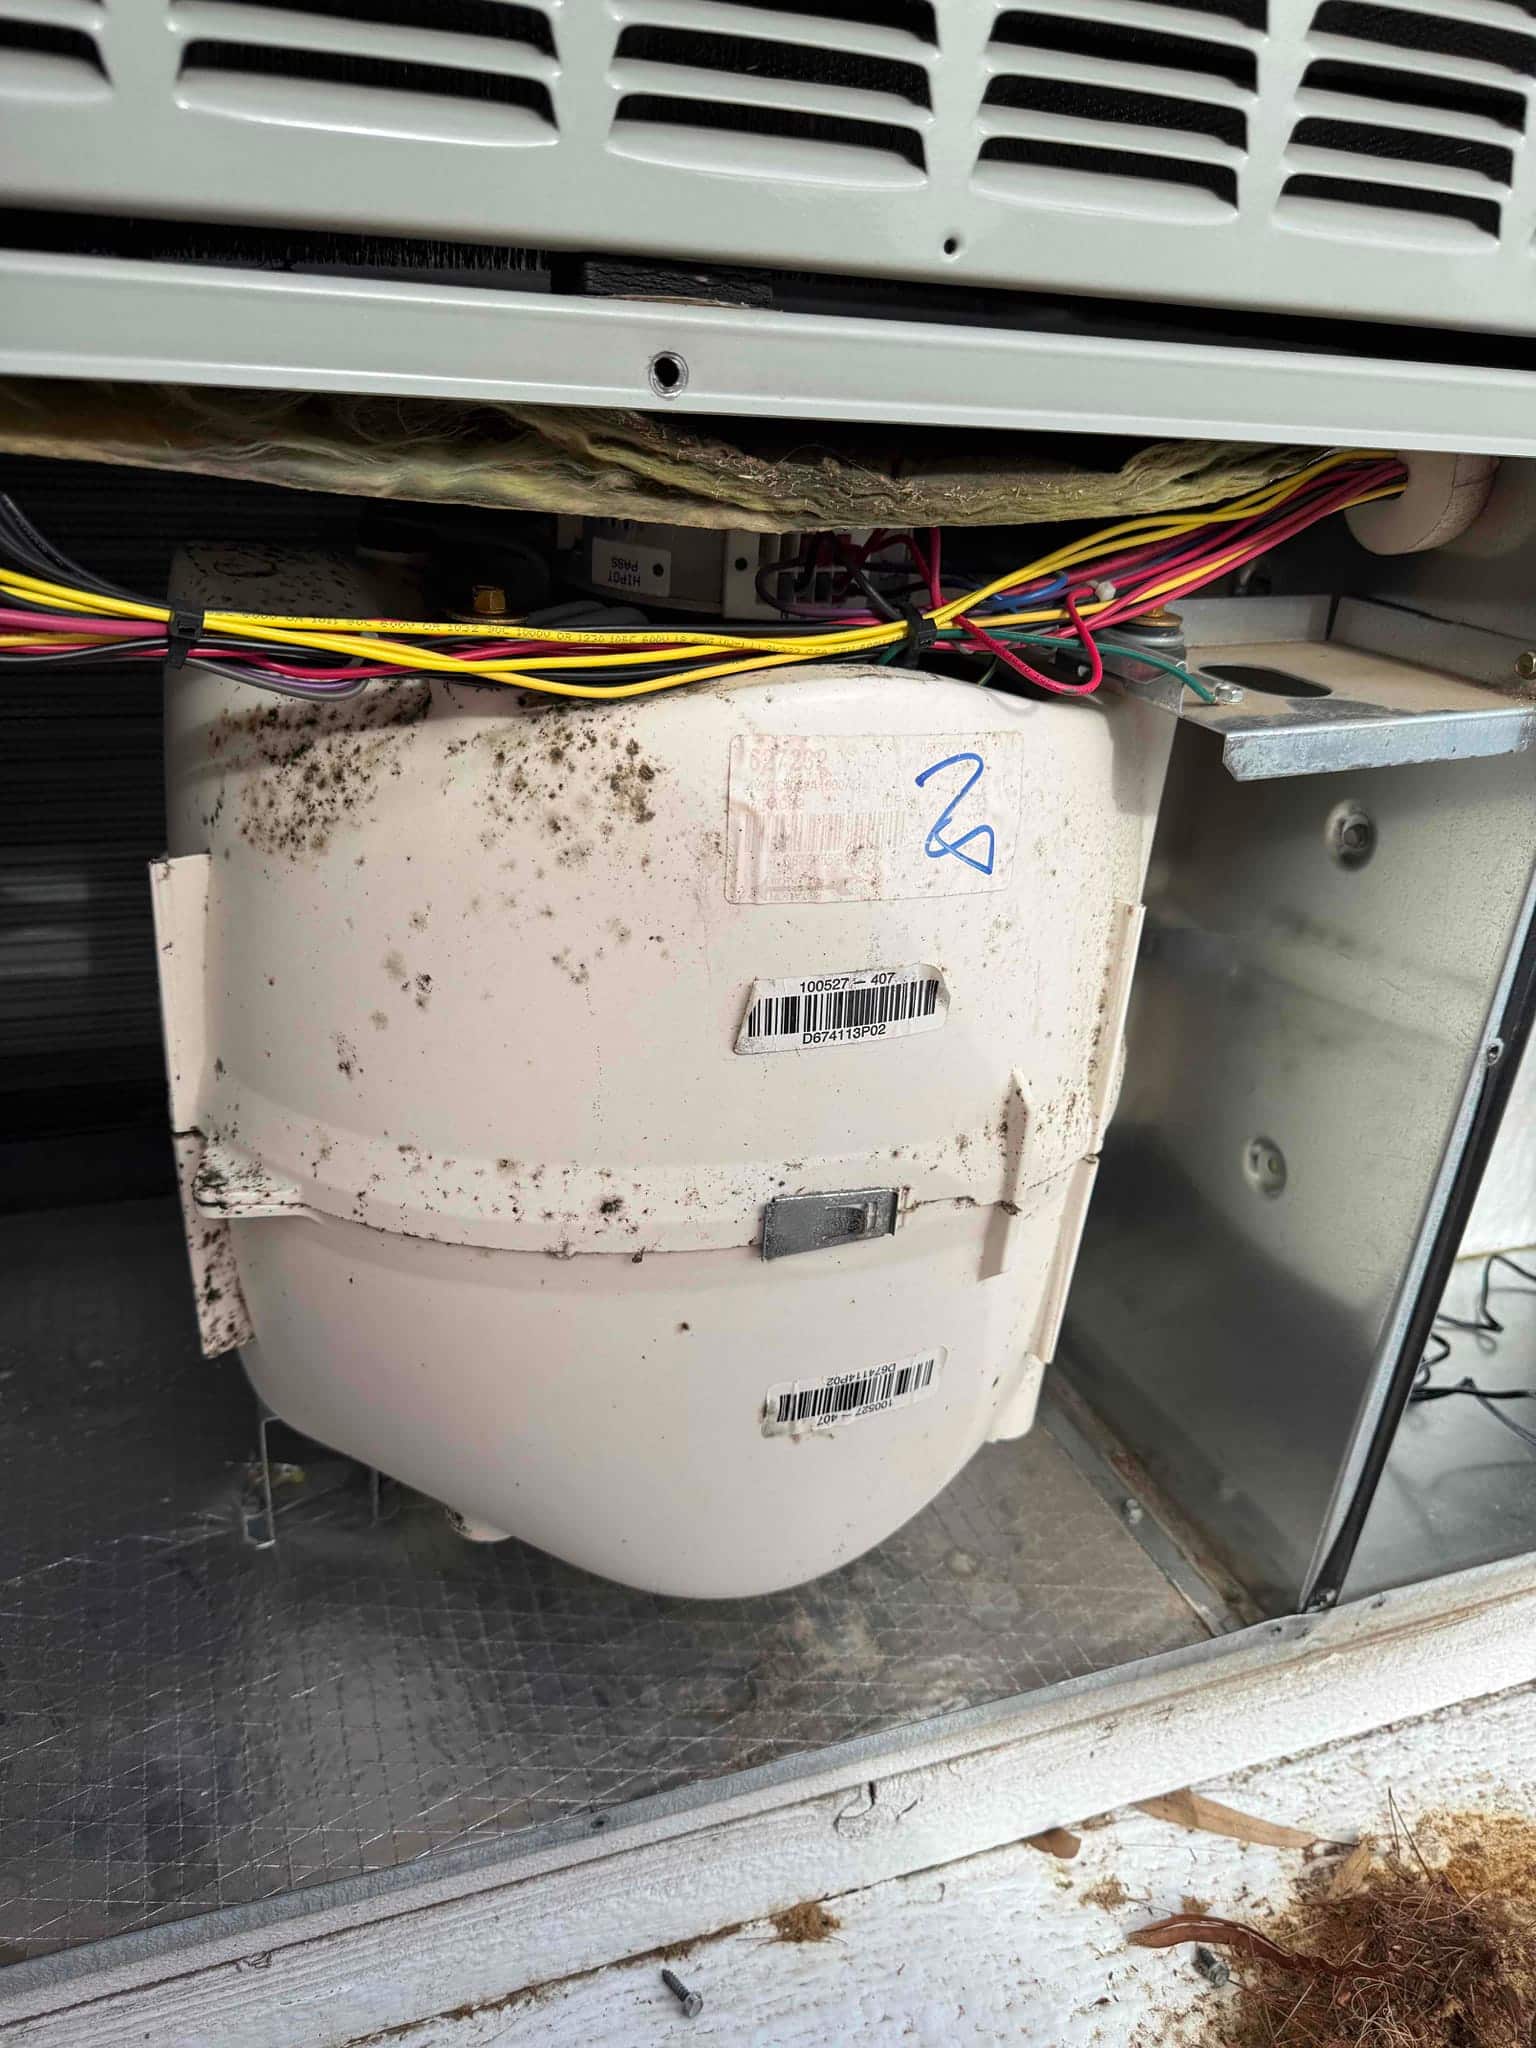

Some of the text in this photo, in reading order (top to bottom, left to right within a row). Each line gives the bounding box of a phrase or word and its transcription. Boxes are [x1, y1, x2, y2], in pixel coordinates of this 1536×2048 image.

[800, 978, 850, 993] 100527
[870, 971, 896, 986] 407
[802, 1023, 887, 1045] D674113P02
[826, 1363, 897, 1386] D674114P02
[855, 1399, 892, 1416] 100527
[816, 1414, 838, 1427] 407
